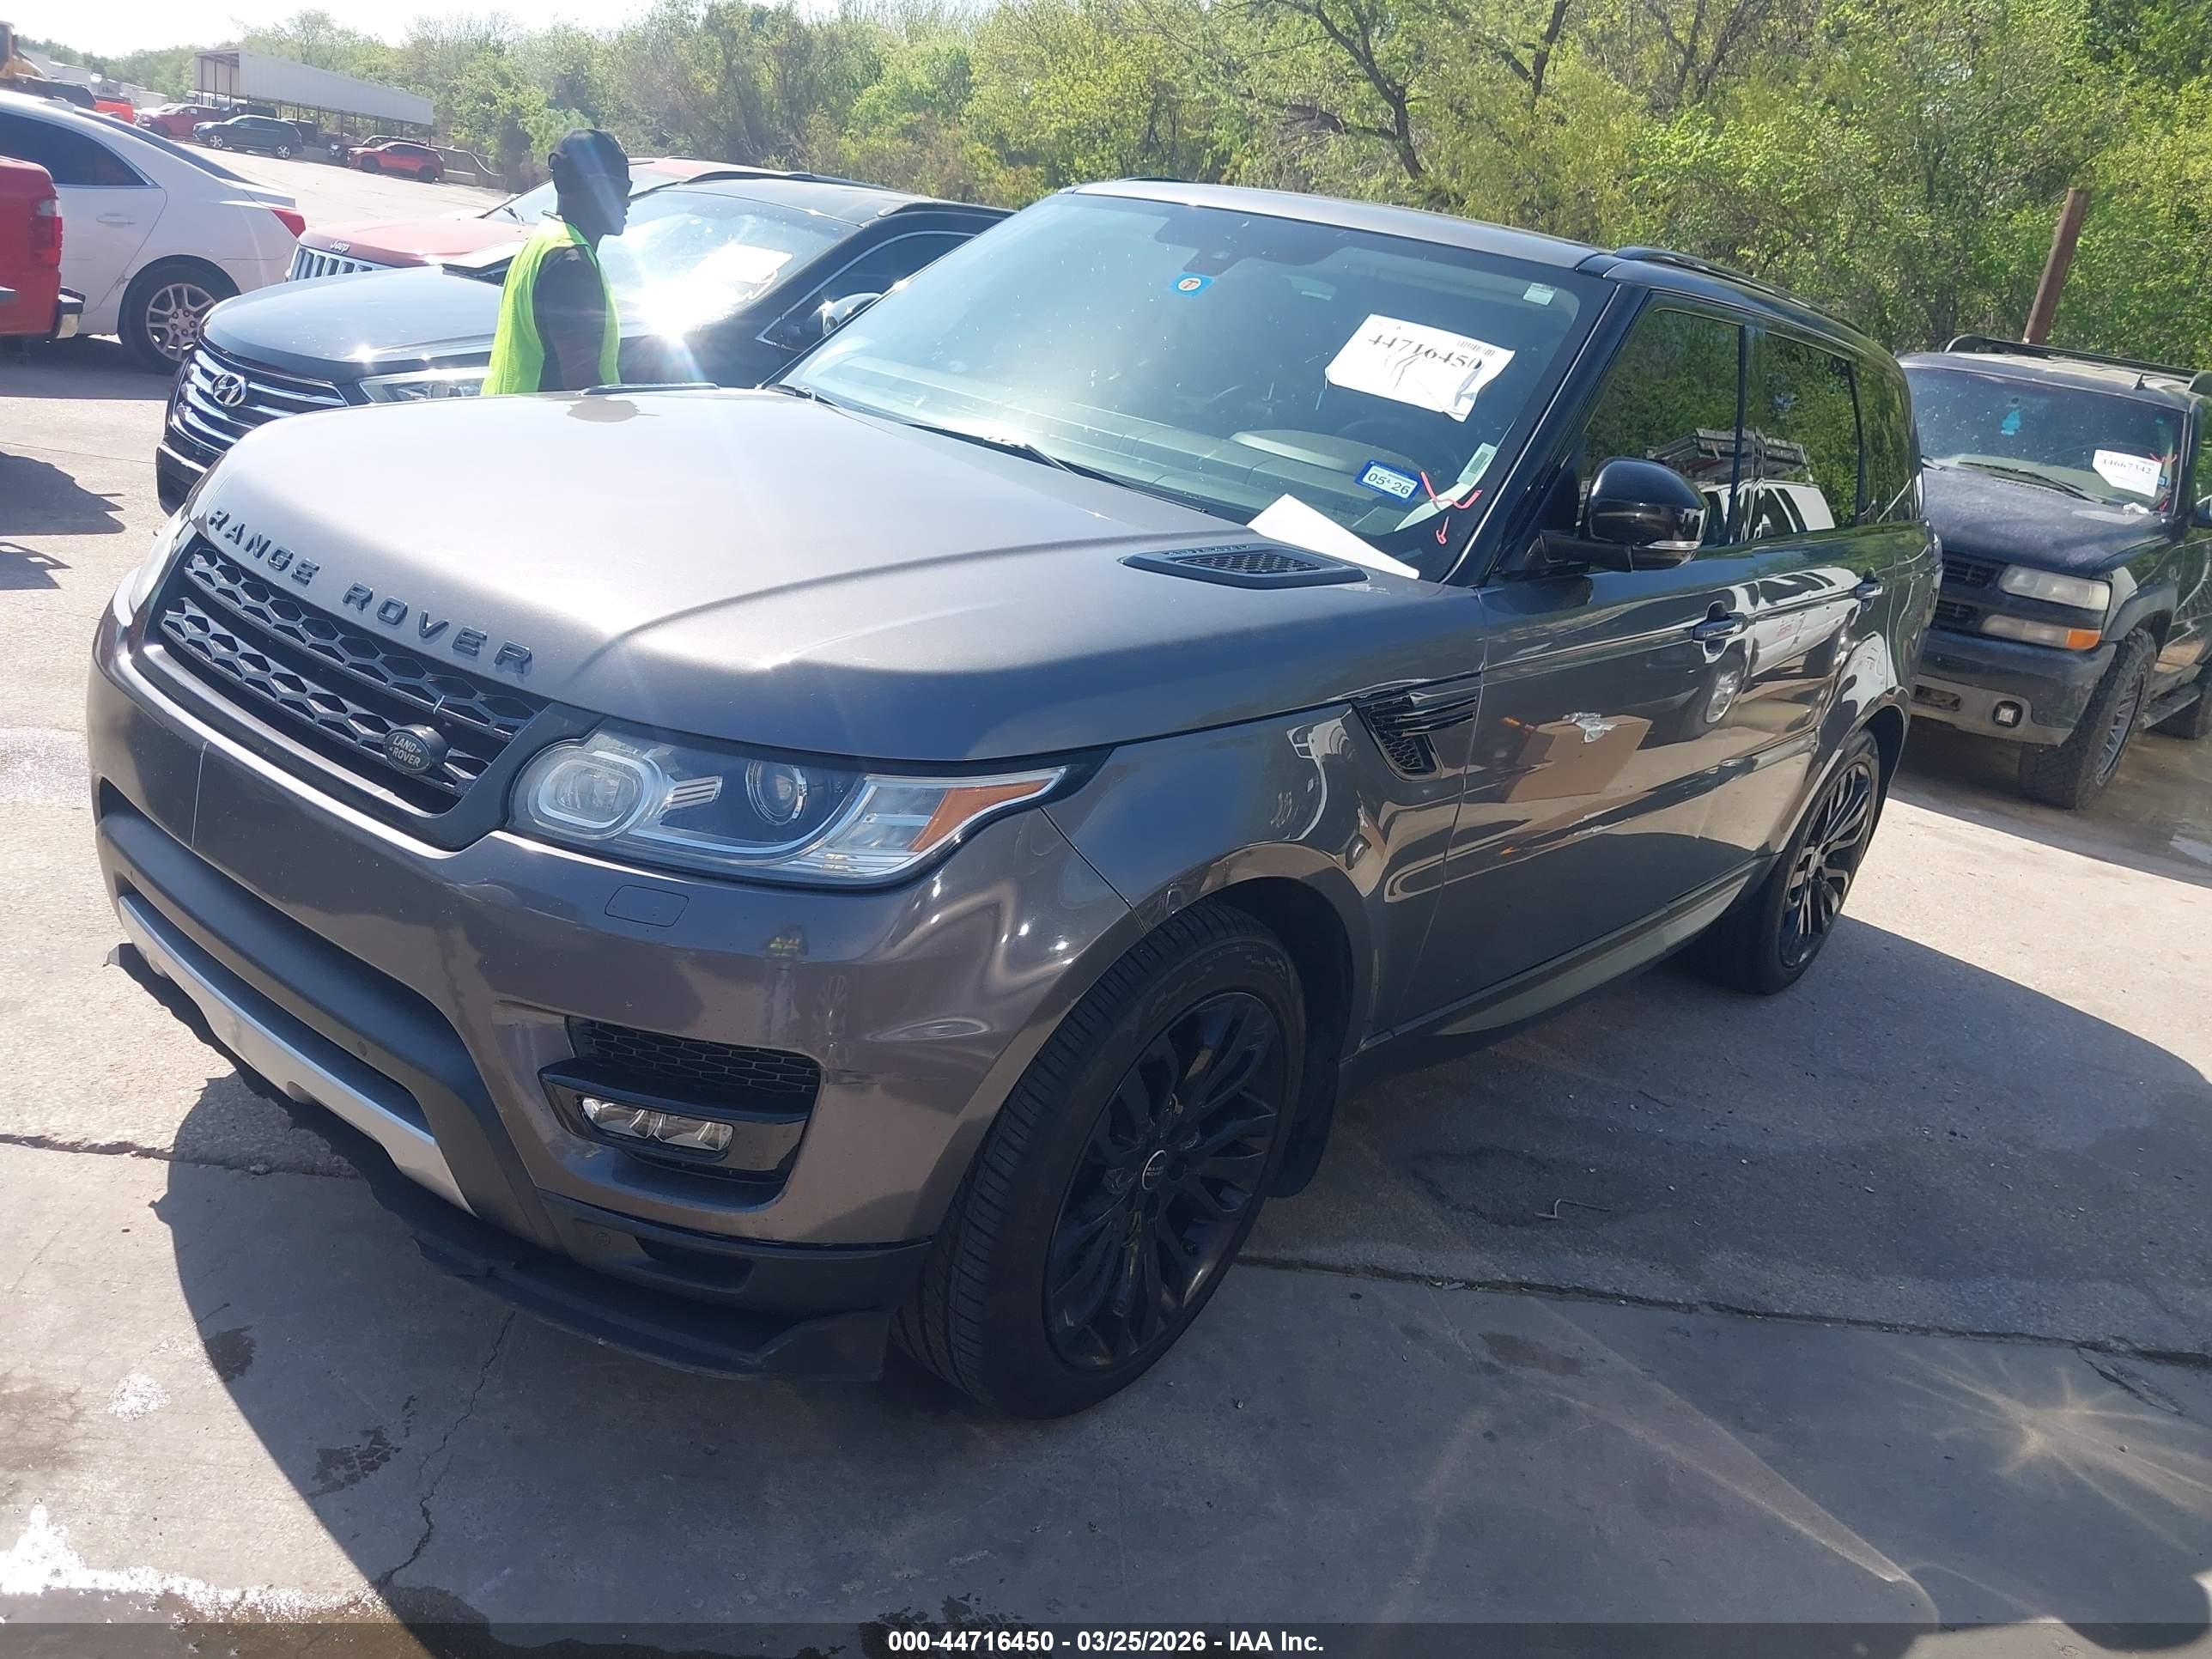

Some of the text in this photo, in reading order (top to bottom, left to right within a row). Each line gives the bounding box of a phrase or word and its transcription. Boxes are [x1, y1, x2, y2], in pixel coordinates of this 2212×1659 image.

[330, 240, 350, 253] Jeep
[1368, 334, 1484, 370] 44716450
[1367, 472, 1388, 485] 05
[1390, 482, 1411, 495] 26
[209, 509, 533, 674] RANGE ROVER
[392, 734, 417, 753] LAND
[392, 746, 422, 768] ROVER
